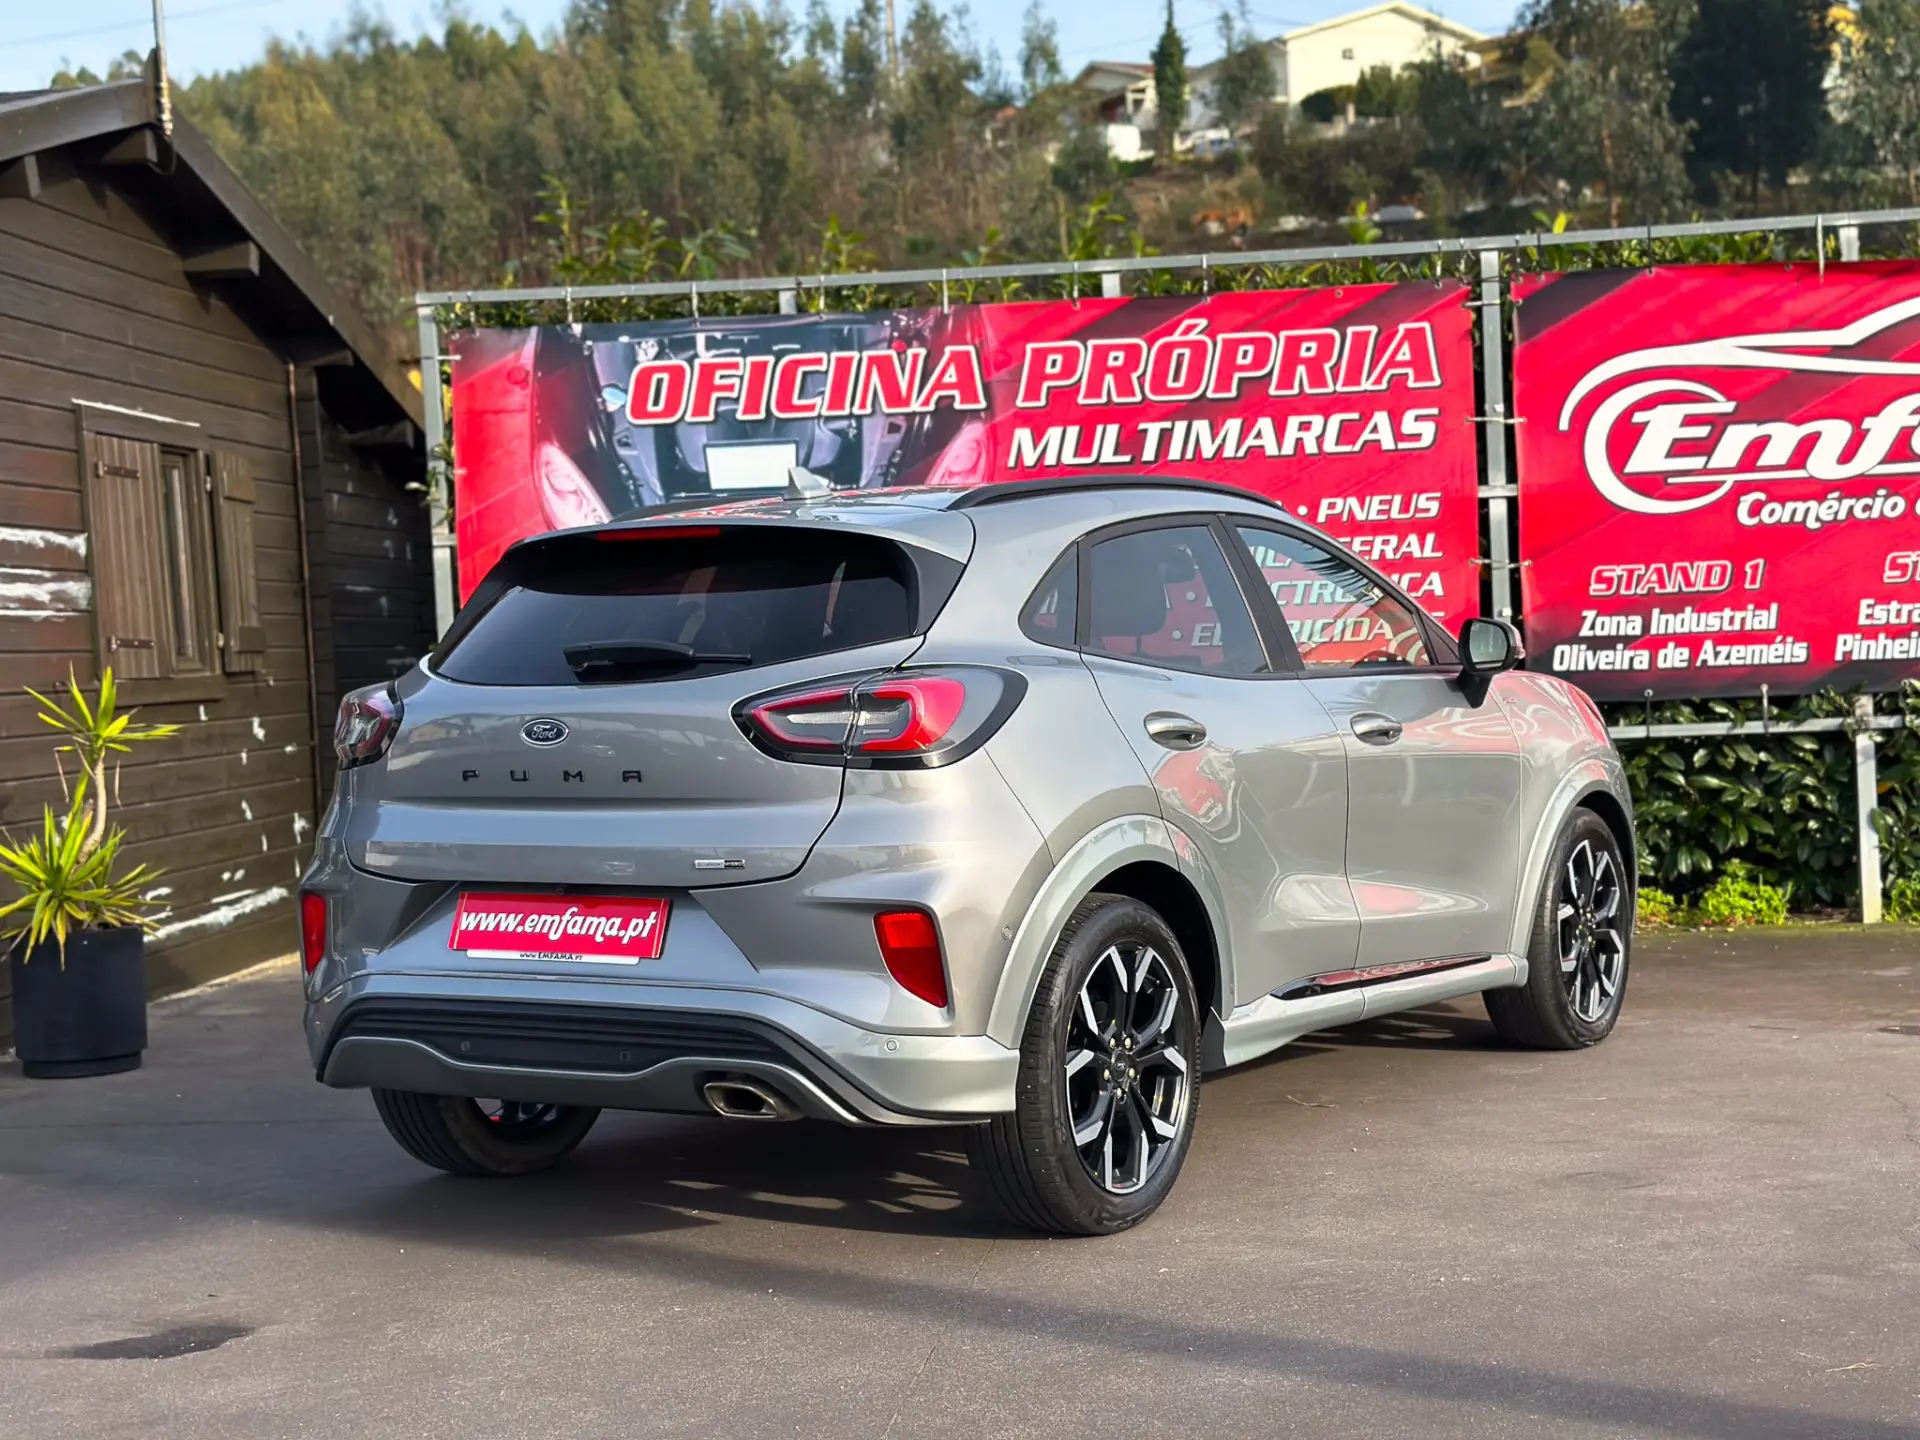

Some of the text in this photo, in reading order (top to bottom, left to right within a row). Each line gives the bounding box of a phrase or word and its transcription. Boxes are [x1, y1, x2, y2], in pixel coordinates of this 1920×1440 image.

[625, 318, 1442, 426] OFICINA PRÓPRIA
[1007, 407, 1439, 468] MULTIMARCAS
[1623, 391, 1920, 481] Emf
[1316, 492, 1442, 523] PNEUS
[1737, 488, 1906, 530] Comércio
[1589, 558, 1766, 596] STAND 1
[1579, 602, 1778, 637] Zona Industrial
[1553, 635, 1808, 672] Oliveira de Azeméis
[1834, 630, 1920, 661] Pinhei
[531, 724, 558, 739] Ford
[462, 769, 643, 783] PUMA
[460, 907, 657, 944] www.emfama.pt
